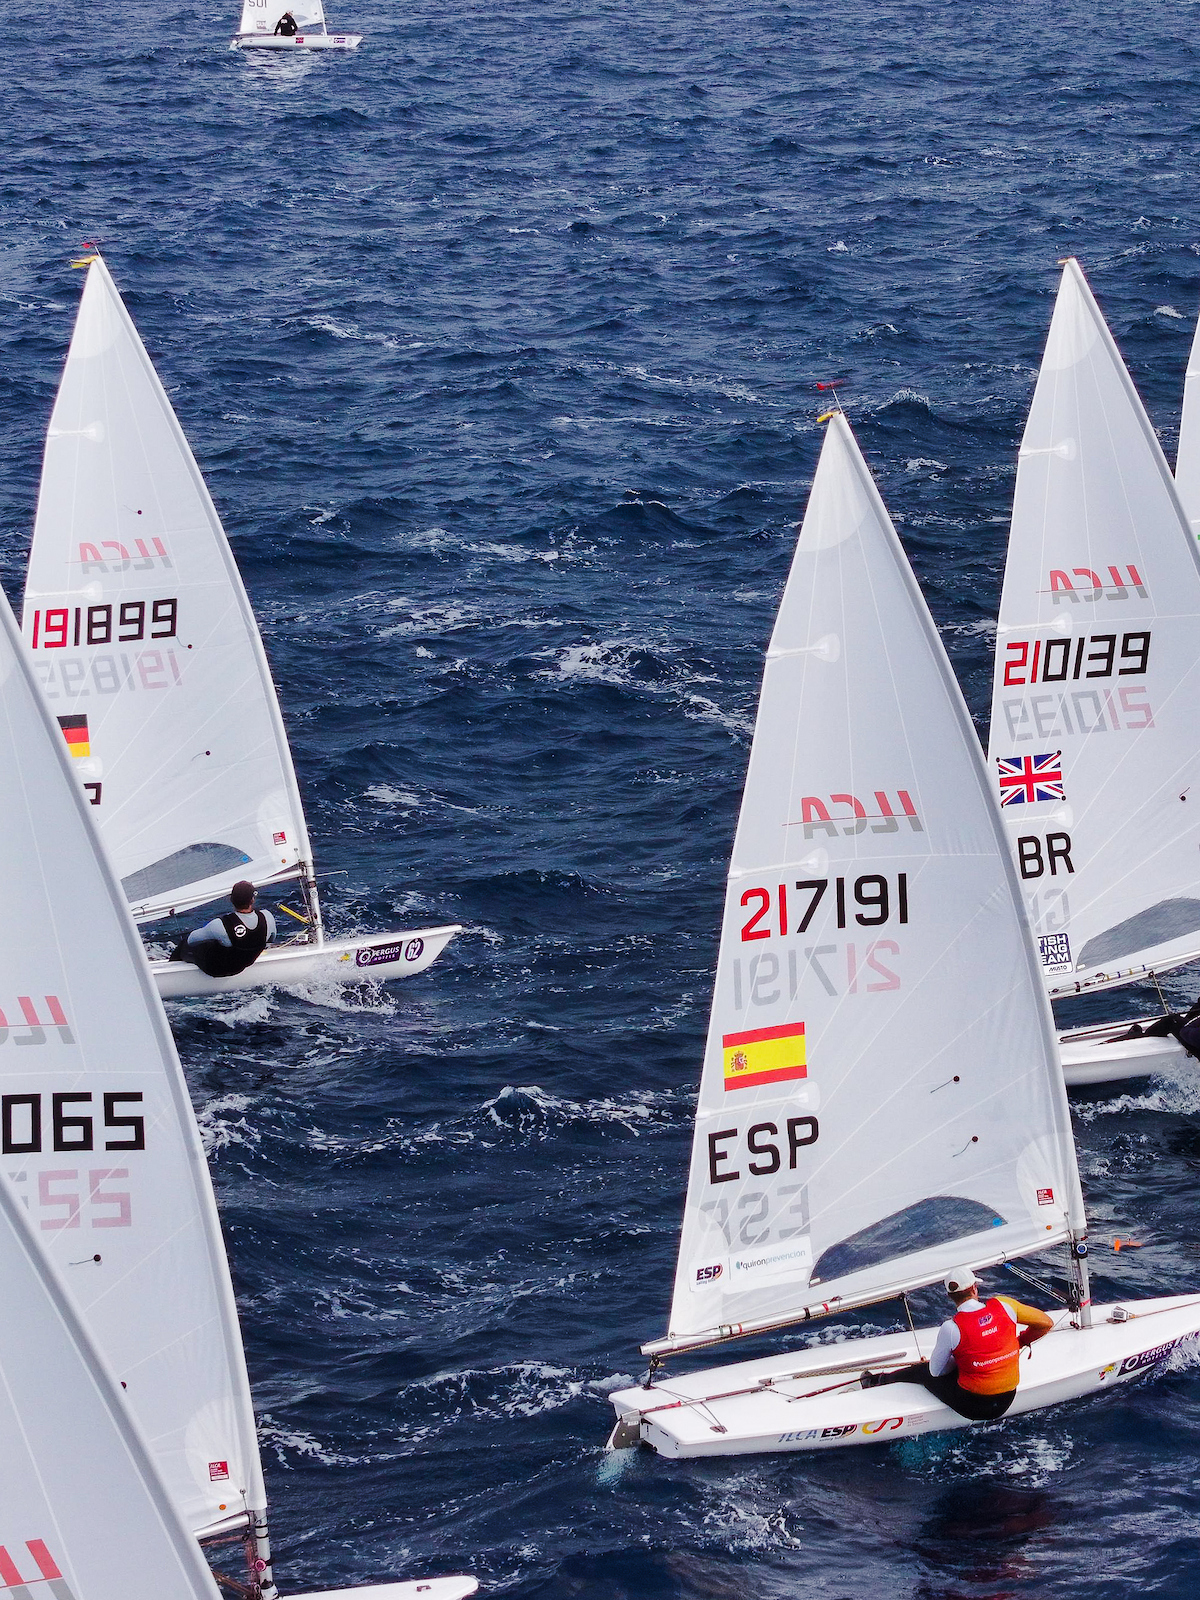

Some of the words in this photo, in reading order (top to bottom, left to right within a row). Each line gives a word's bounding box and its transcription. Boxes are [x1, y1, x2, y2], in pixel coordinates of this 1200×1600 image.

[32, 598, 178, 649] 191899
[1003, 631, 1151, 686] 210139
[1018, 832, 1075, 879] BR
[740, 873, 909, 942] 217191
[372, 945, 400, 957] FERGUS
[406, 940, 421, 959] 62
[2, 1092, 145, 1154] 065
[708, 1115, 819, 1185] ESP
[696, 1265, 722, 1281] ESP
[1140, 1341, 1174, 1360] FERGUS
[778, 1429, 817, 1443] ILCA
[821, 1424, 857, 1439] ESP
